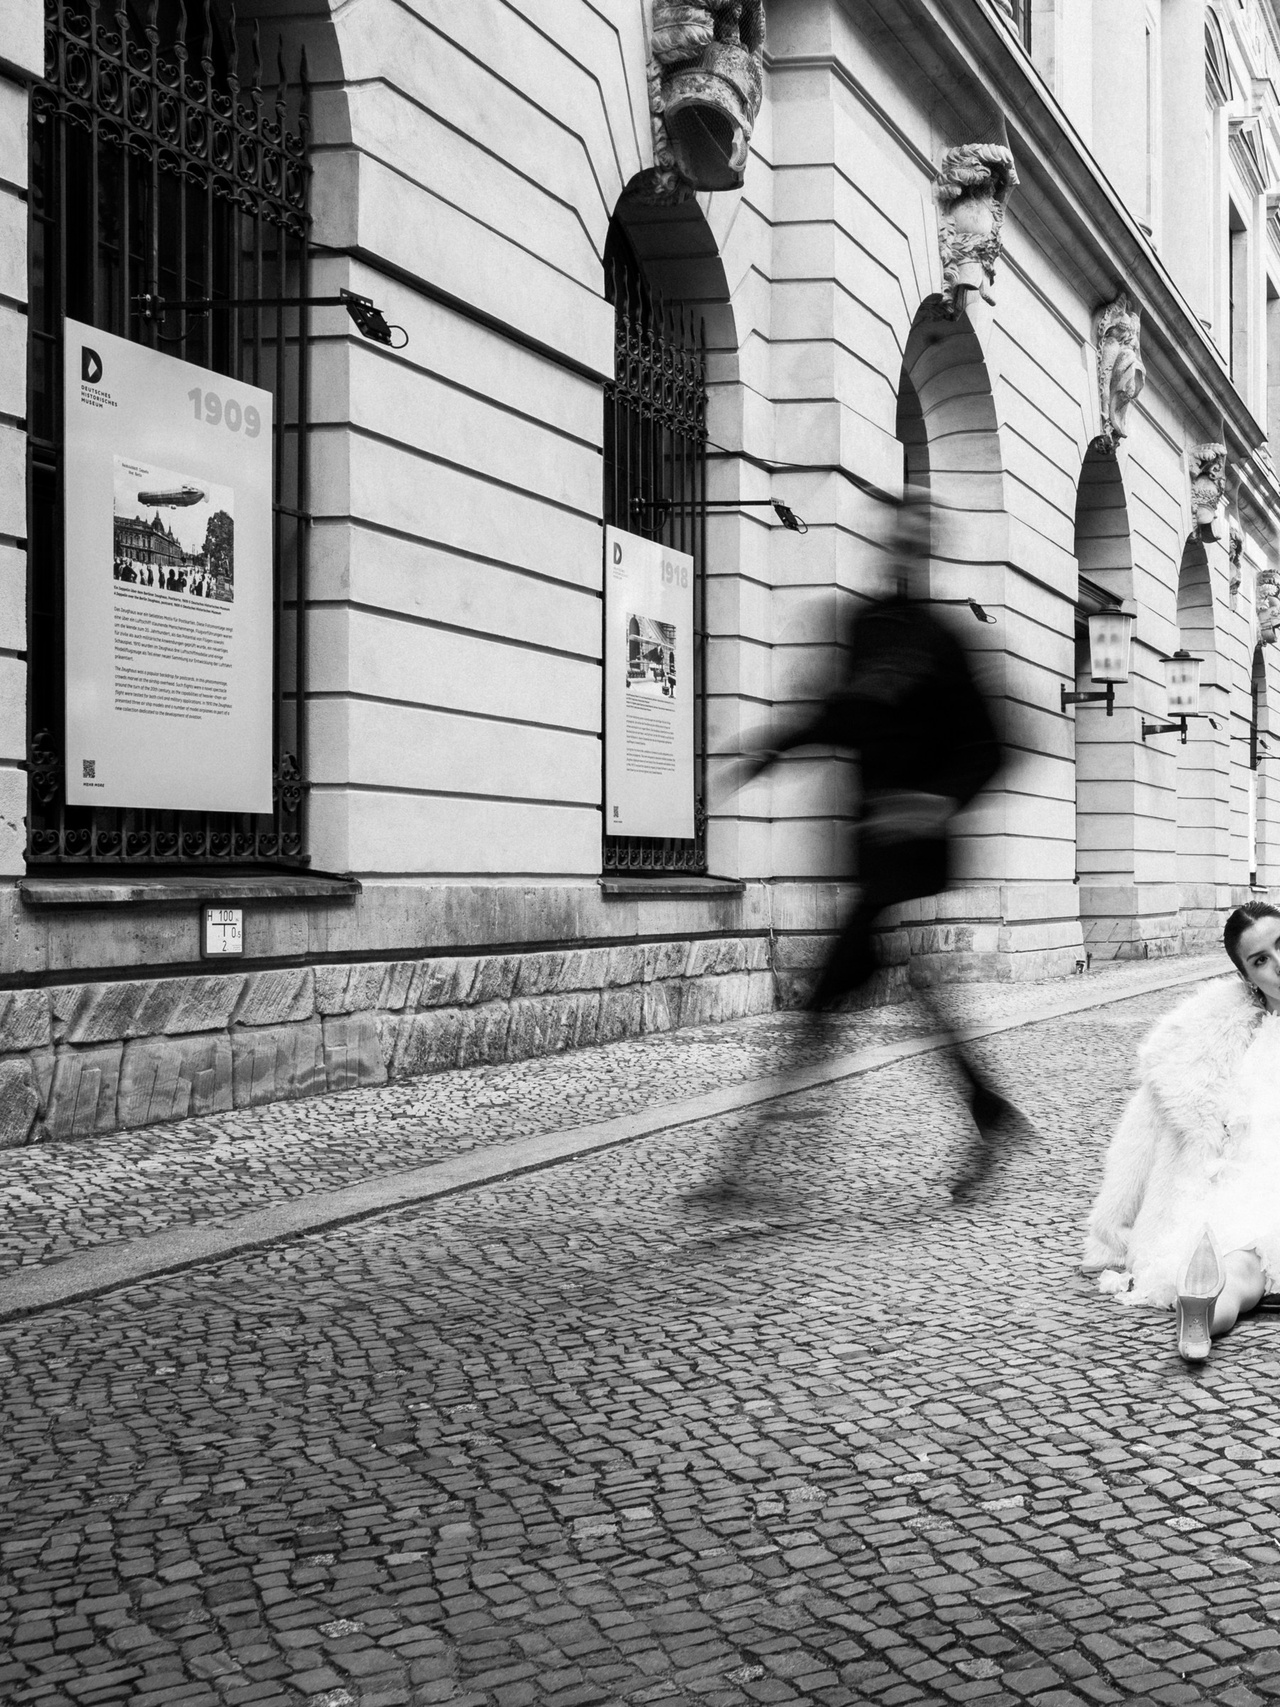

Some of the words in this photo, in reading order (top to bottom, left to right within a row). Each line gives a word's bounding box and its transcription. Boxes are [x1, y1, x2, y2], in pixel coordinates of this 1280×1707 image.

[81, 385, 111, 399] DEUTSCHES
[81, 392, 118, 407] HISTORISCHES
[81, 398, 104, 408] MUSEUM
[188, 387, 261, 438] 1909
[661, 560, 688, 588] 1918
[208, 910, 212, 921] H
[219, 910, 233, 921] 100
[222, 940, 227, 951] 2
